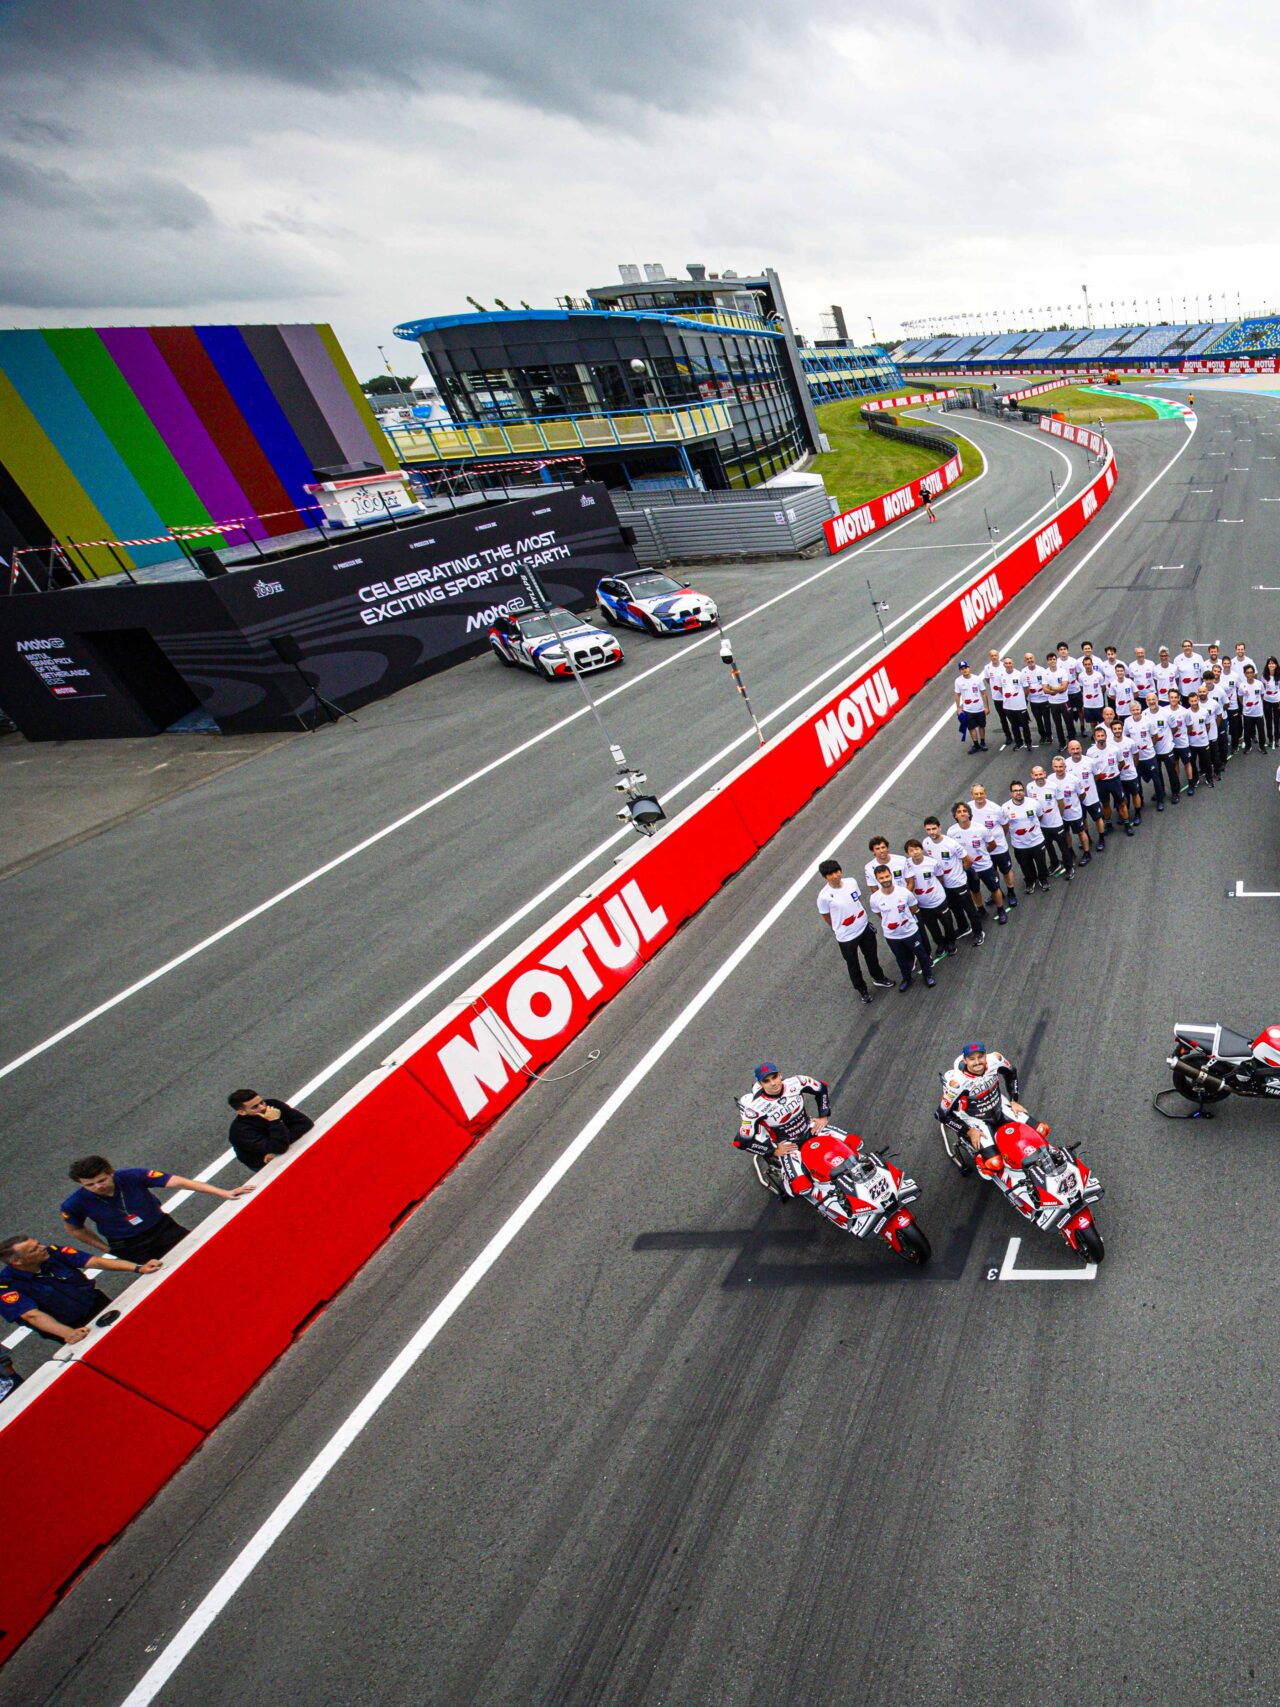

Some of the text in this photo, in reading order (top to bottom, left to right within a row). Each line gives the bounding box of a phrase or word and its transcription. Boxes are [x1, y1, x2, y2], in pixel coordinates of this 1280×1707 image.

[832, 506, 875, 548] MOTUL
[883, 487, 915, 522] MOTUL
[358, 530, 555, 603] CELEBRATING THE MOST
[1035, 521, 1063, 563] MOTUL
[360, 586, 446, 625] EXCITING
[444, 567, 498, 597] SPORT
[523, 545, 571, 568] EARTH
[960, 573, 1004, 633] MOTUL
[815, 666, 899, 768] MOTUL
[437, 879, 669, 1121] MOTUL
[771, 1095, 802, 1122] prima
[1057, 1172, 1078, 1195] 43
